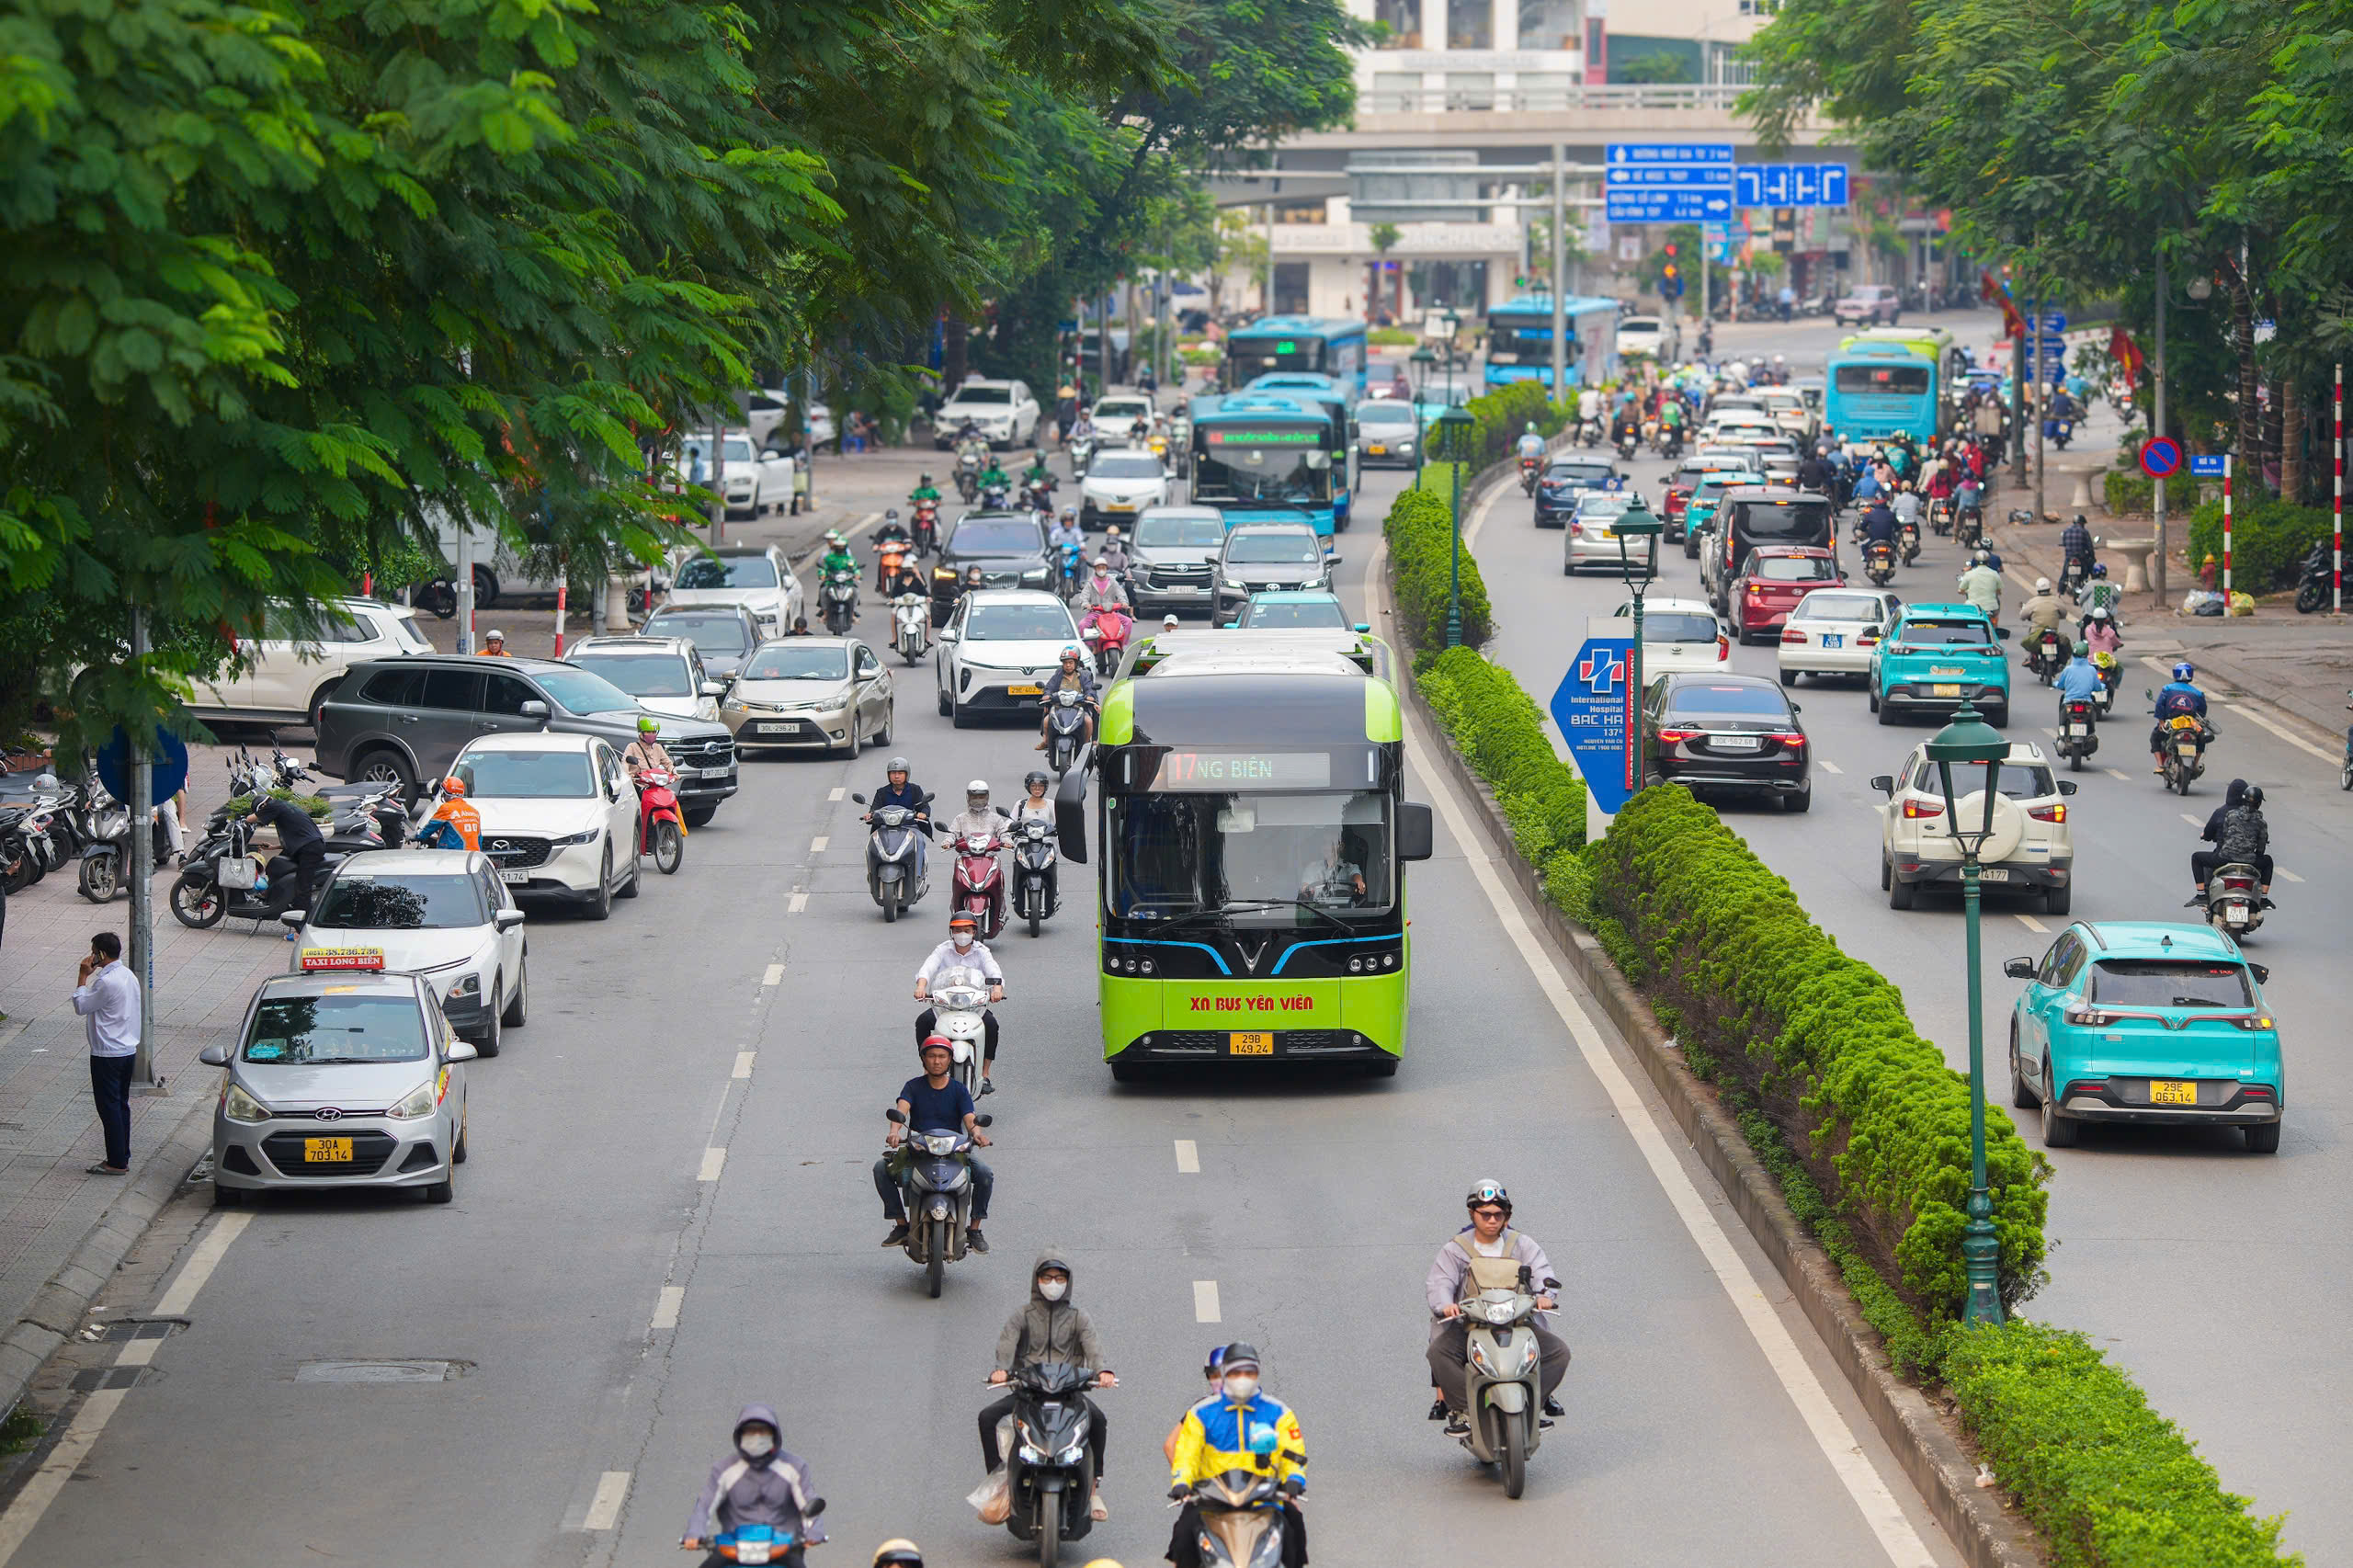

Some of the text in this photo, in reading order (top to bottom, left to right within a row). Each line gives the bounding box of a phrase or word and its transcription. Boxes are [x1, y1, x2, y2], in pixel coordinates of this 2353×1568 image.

[1571, 715, 1623, 724] BAC HA
[1173, 753, 1272, 780] 17 NG BIÊN
[358, 956, 381, 965] BIÊN
[1190, 994, 1313, 1011] XN BUS YÊN VIÊN
[1242, 1034, 1261, 1043] 29B
[1235, 1044, 1268, 1053] 149.24
[2164, 1083, 2184, 1092] 29E
[2155, 1092, 2191, 1103] 063.14
[318, 1139, 339, 1150] 30A
[310, 1150, 347, 1161] 703.14
